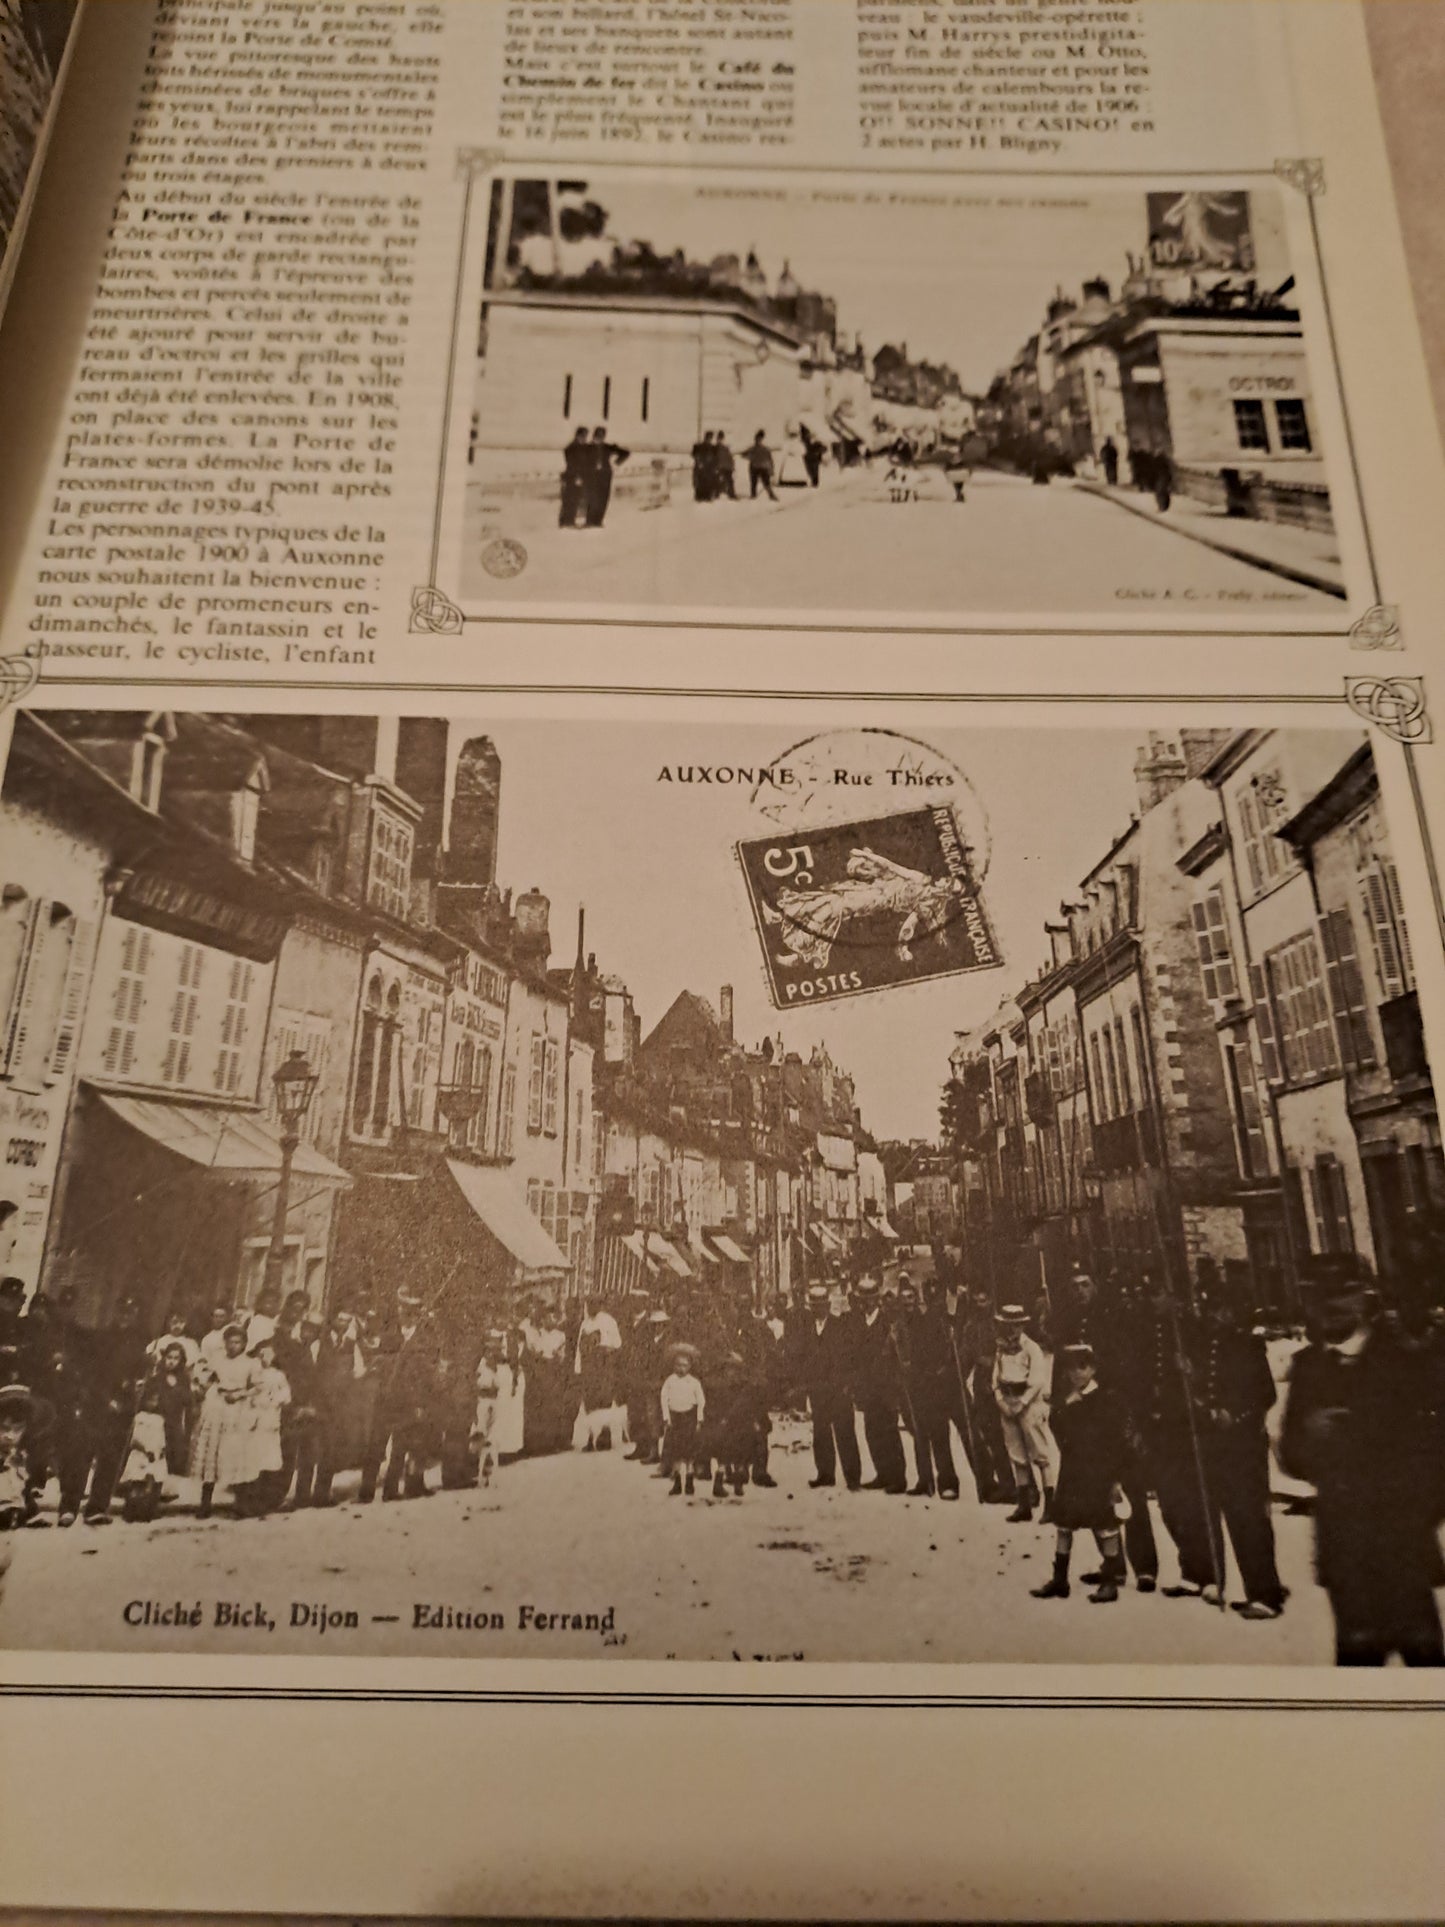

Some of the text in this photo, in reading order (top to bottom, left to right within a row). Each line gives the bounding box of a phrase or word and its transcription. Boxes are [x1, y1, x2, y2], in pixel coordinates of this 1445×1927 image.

[112, 206, 420, 228] la Porte de France de la
[96, 285, 176, 300] bombes
[182, 287, 200, 302] et
[276, 289, 382, 304] seulement
[386, 290, 412, 306] de
[226, 308, 388, 326] Celui de droite
[87, 325, 360, 347] été ajouré pour servir de
[84, 347, 405, 370] reau d'octroi et les grilles qui
[80, 367, 403, 388] fermaient l'entrée de la ville
[1228, 375, 1295, 392] OCTROI
[75, 389, 337, 408] ont déjà été En
[70, 411, 398, 431] on place des canons sur les
[250, 434, 278, 451] La
[294, 435, 355, 452] Porte
[369, 436, 396, 453] de
[62, 453, 393, 474] France sera démolie lors de la
[57, 477, 392, 501] reconstruction du pont après
[52, 498, 182, 519] la guerre de
[48, 521, 386, 545] Les personnages typiques de la
[42, 545, 96, 561] carte
[106, 546, 186, 566] postale
[199, 547, 249, 564] 1900
[282, 549, 384, 566] Auxonne
[38, 570, 366, 589] nous souhaitent la bienvenue
[34, 593, 380, 616] un couple de promeneurs en-
[28, 617, 377, 639] dimanchés, le fantassin et le
[24, 643, 376, 666] chasseur, le cycliste, l'enfant
[657, 766, 795, 785] AUXONNE
[833, 769, 873, 786] Rue
[886, 769, 954, 787] Thiers
[785, 971, 863, 1000] POSTES
[122, 1600, 202, 1629] Cliché
[213, 1602, 276, 1632] Bick,
[289, 1603, 359, 1634] Dijon
[412, 1604, 505, 1630] Edition
[517, 1605, 615, 1632] Ferrand
